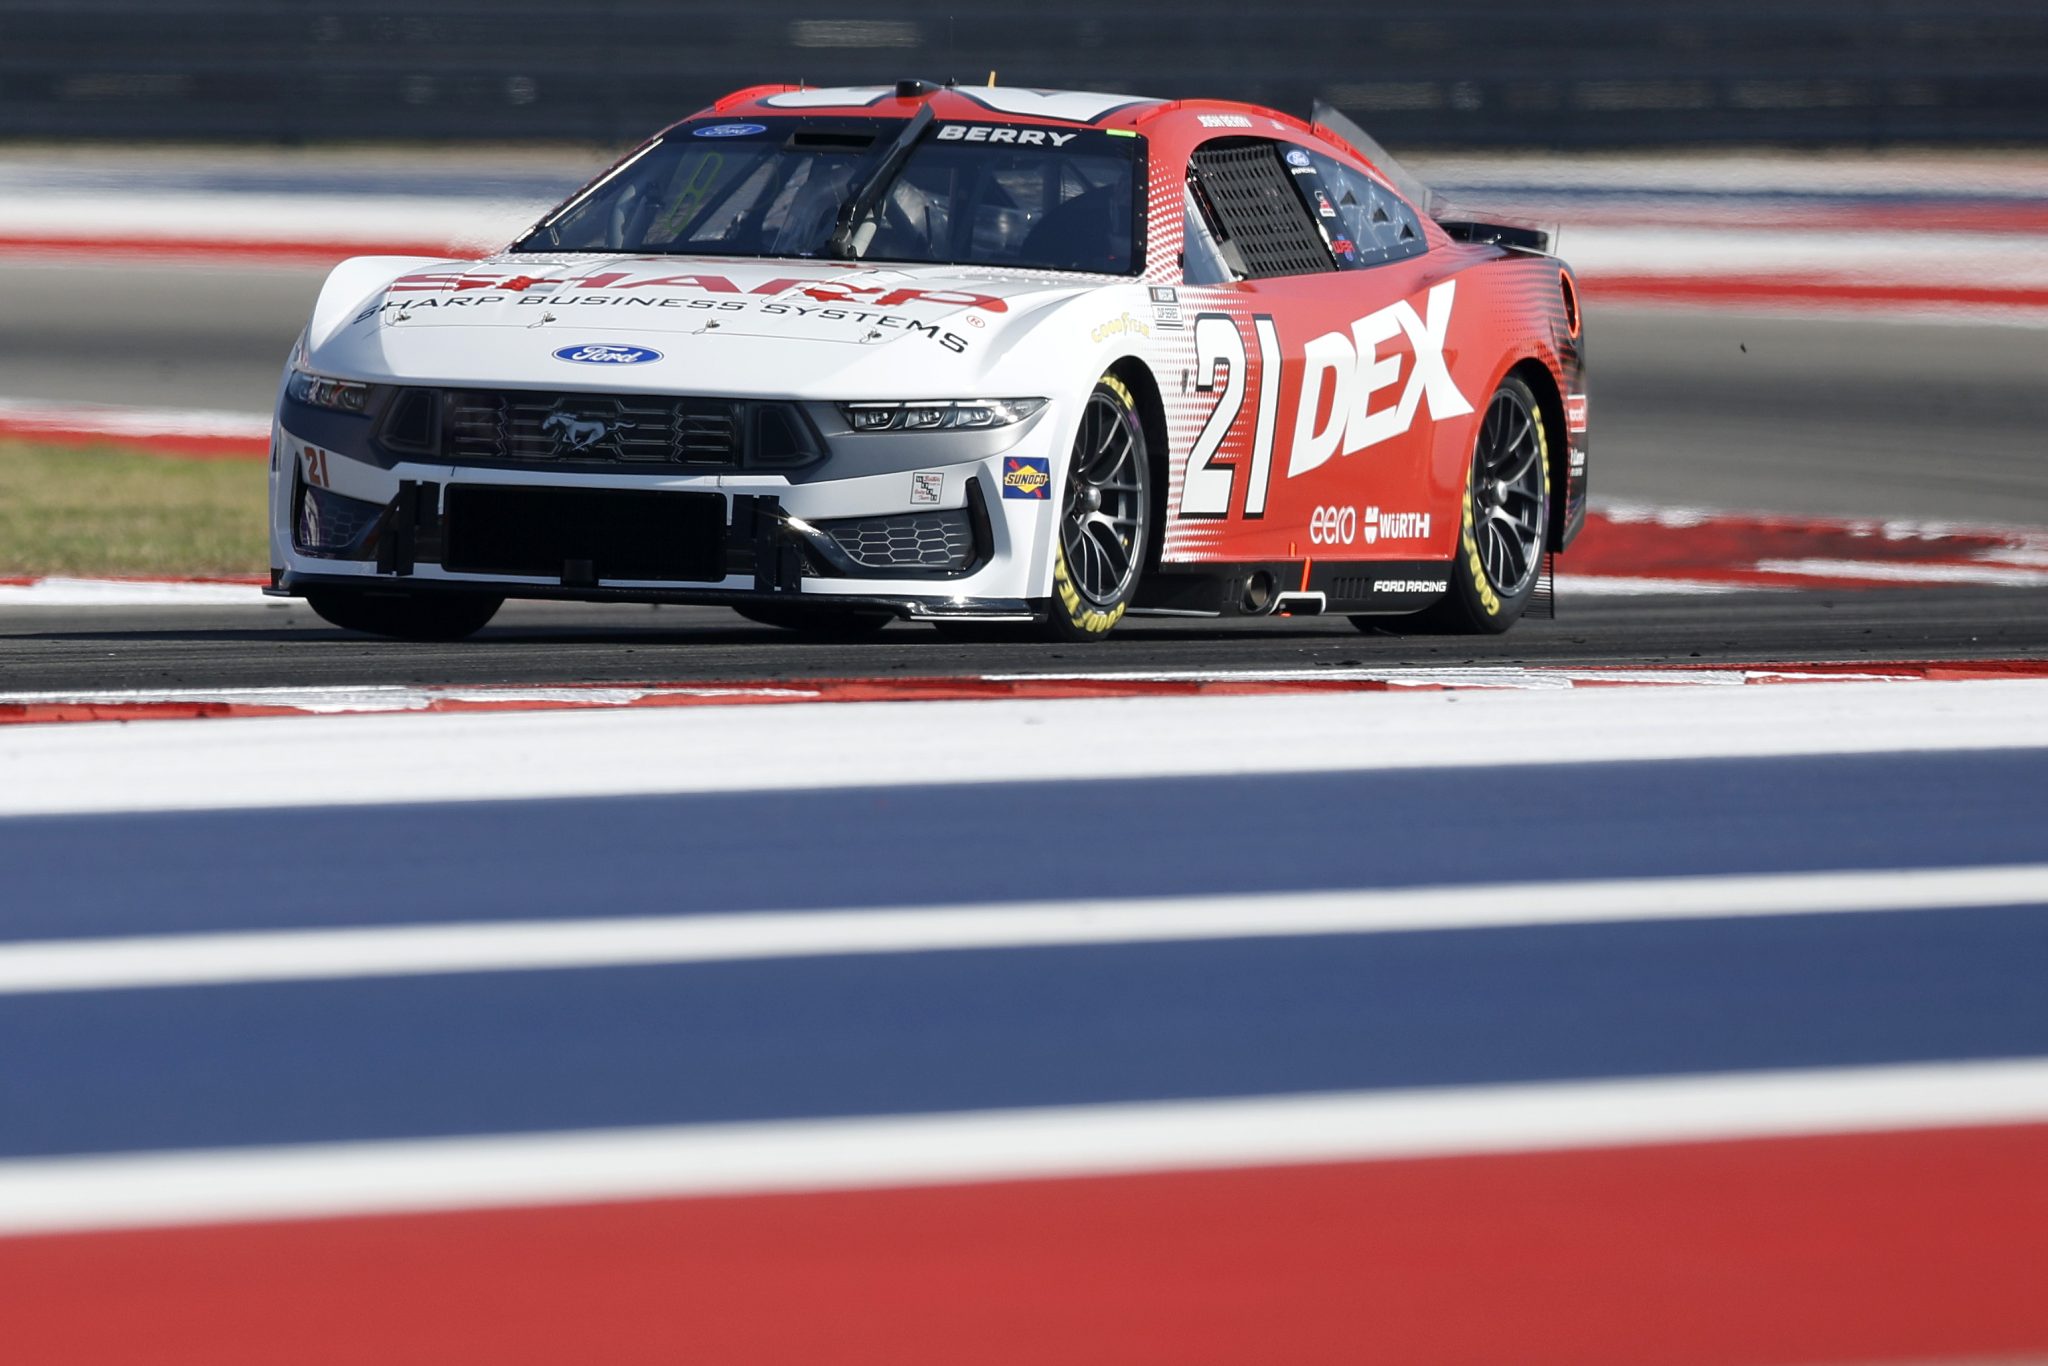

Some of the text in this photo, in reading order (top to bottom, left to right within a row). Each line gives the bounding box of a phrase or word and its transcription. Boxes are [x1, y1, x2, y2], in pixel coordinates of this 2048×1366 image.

[937, 125, 1077, 147] BERRY
[385, 272, 1008, 313] SHARP
[353, 296, 968, 354] SHARP BUSINESS SYSTEMS
[1091, 312, 1151, 344] GOODYEAR
[1098, 376, 1134, 411] AGLE
[1287, 279, 1475, 479] DEX
[1179, 312, 1282, 520] 21
[303, 446, 330, 489] 21
[1006, 473, 1046, 486] SUNOCO
[1310, 506, 1356, 544] eero
[1373, 580, 1448, 593] FORD RACING
